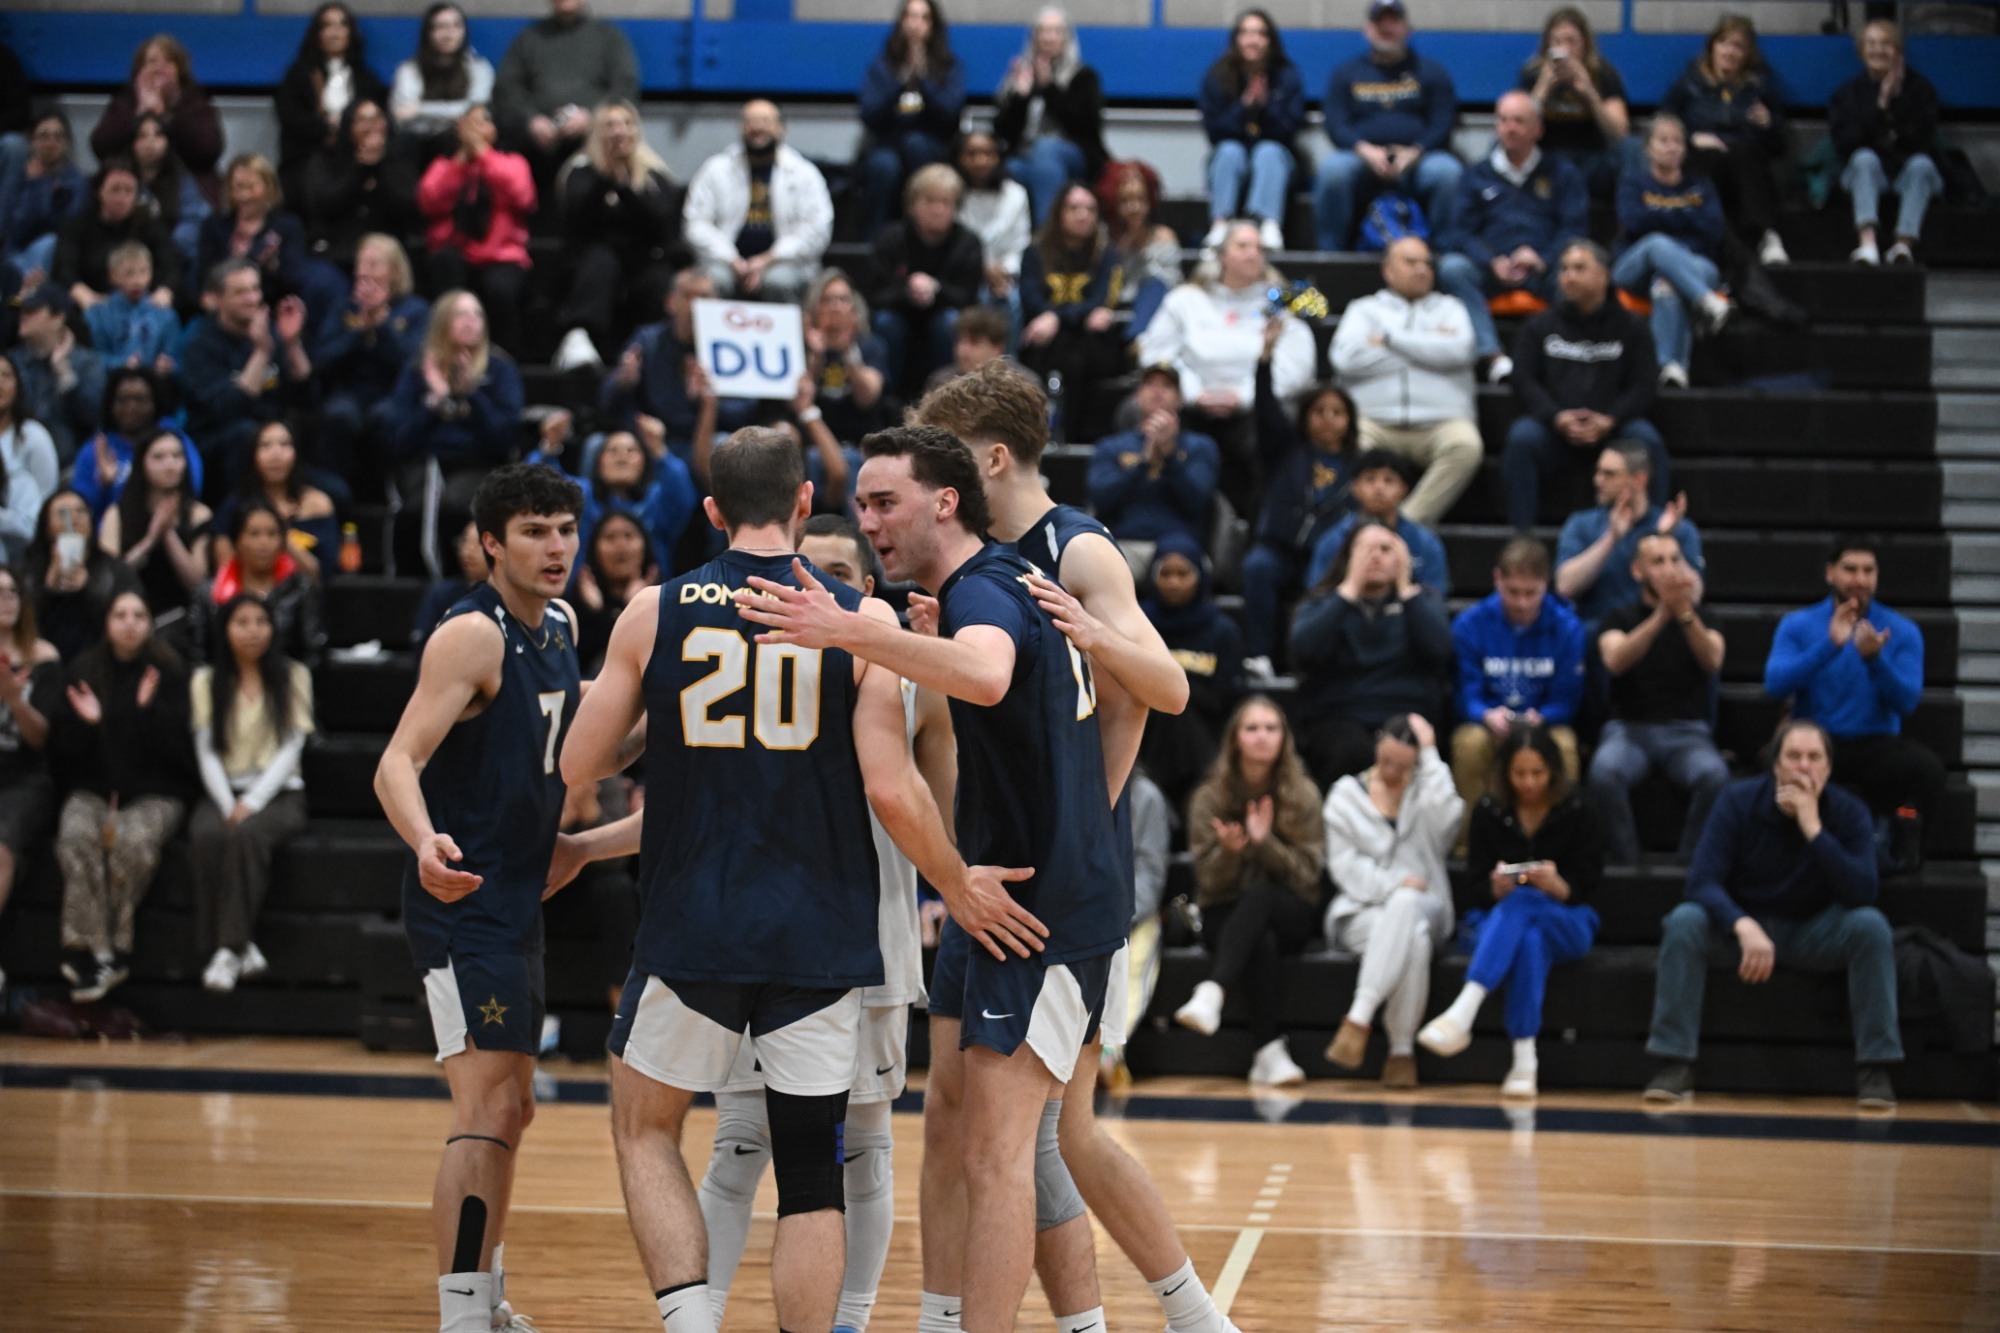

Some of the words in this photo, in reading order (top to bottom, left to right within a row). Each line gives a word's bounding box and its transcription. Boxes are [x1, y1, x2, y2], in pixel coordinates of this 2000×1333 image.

[711, 341, 790, 381] DU
[680, 626, 823, 750] 20
[538, 690, 566, 774] 7
